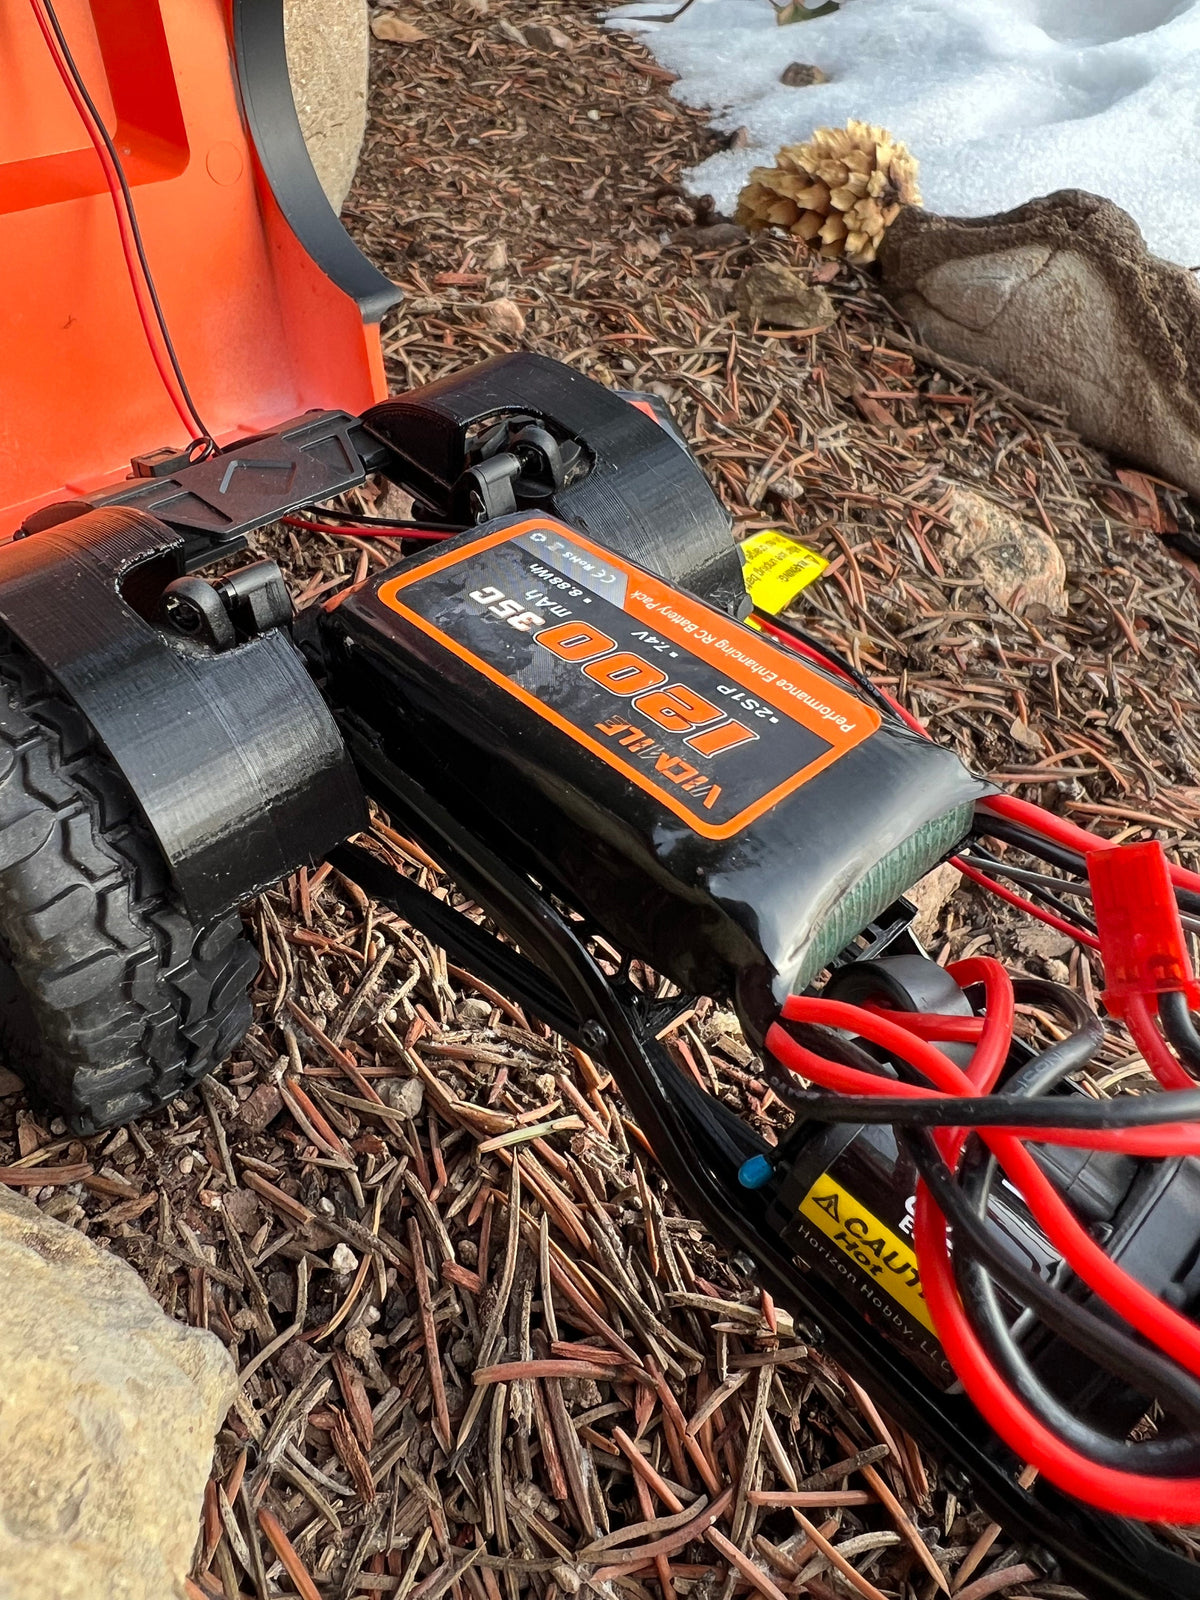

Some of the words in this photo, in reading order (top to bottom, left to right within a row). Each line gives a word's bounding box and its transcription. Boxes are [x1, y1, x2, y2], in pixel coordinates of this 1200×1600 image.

[562, 551, 595, 571] RoHS
[529, 563, 584, 597] 8.88Wh
[469, 586, 546, 632] 35C
[525, 589, 573, 618] mAh
[629, 590, 655, 610] Pack
[657, 605, 698, 633] Battery
[693, 628, 716, 644] RC
[630, 630, 671, 653] 7.4V
[714, 639, 778, 684] Enhancing
[532, 620, 760, 759] 1200
[716, 685, 775, 719] 2S1P
[776, 679, 857, 734] Performance
[798, 1224, 857, 1284] Horizon
[833, 1231, 885, 1277] Hot
[844, 1217, 924, 1299] CAUT
